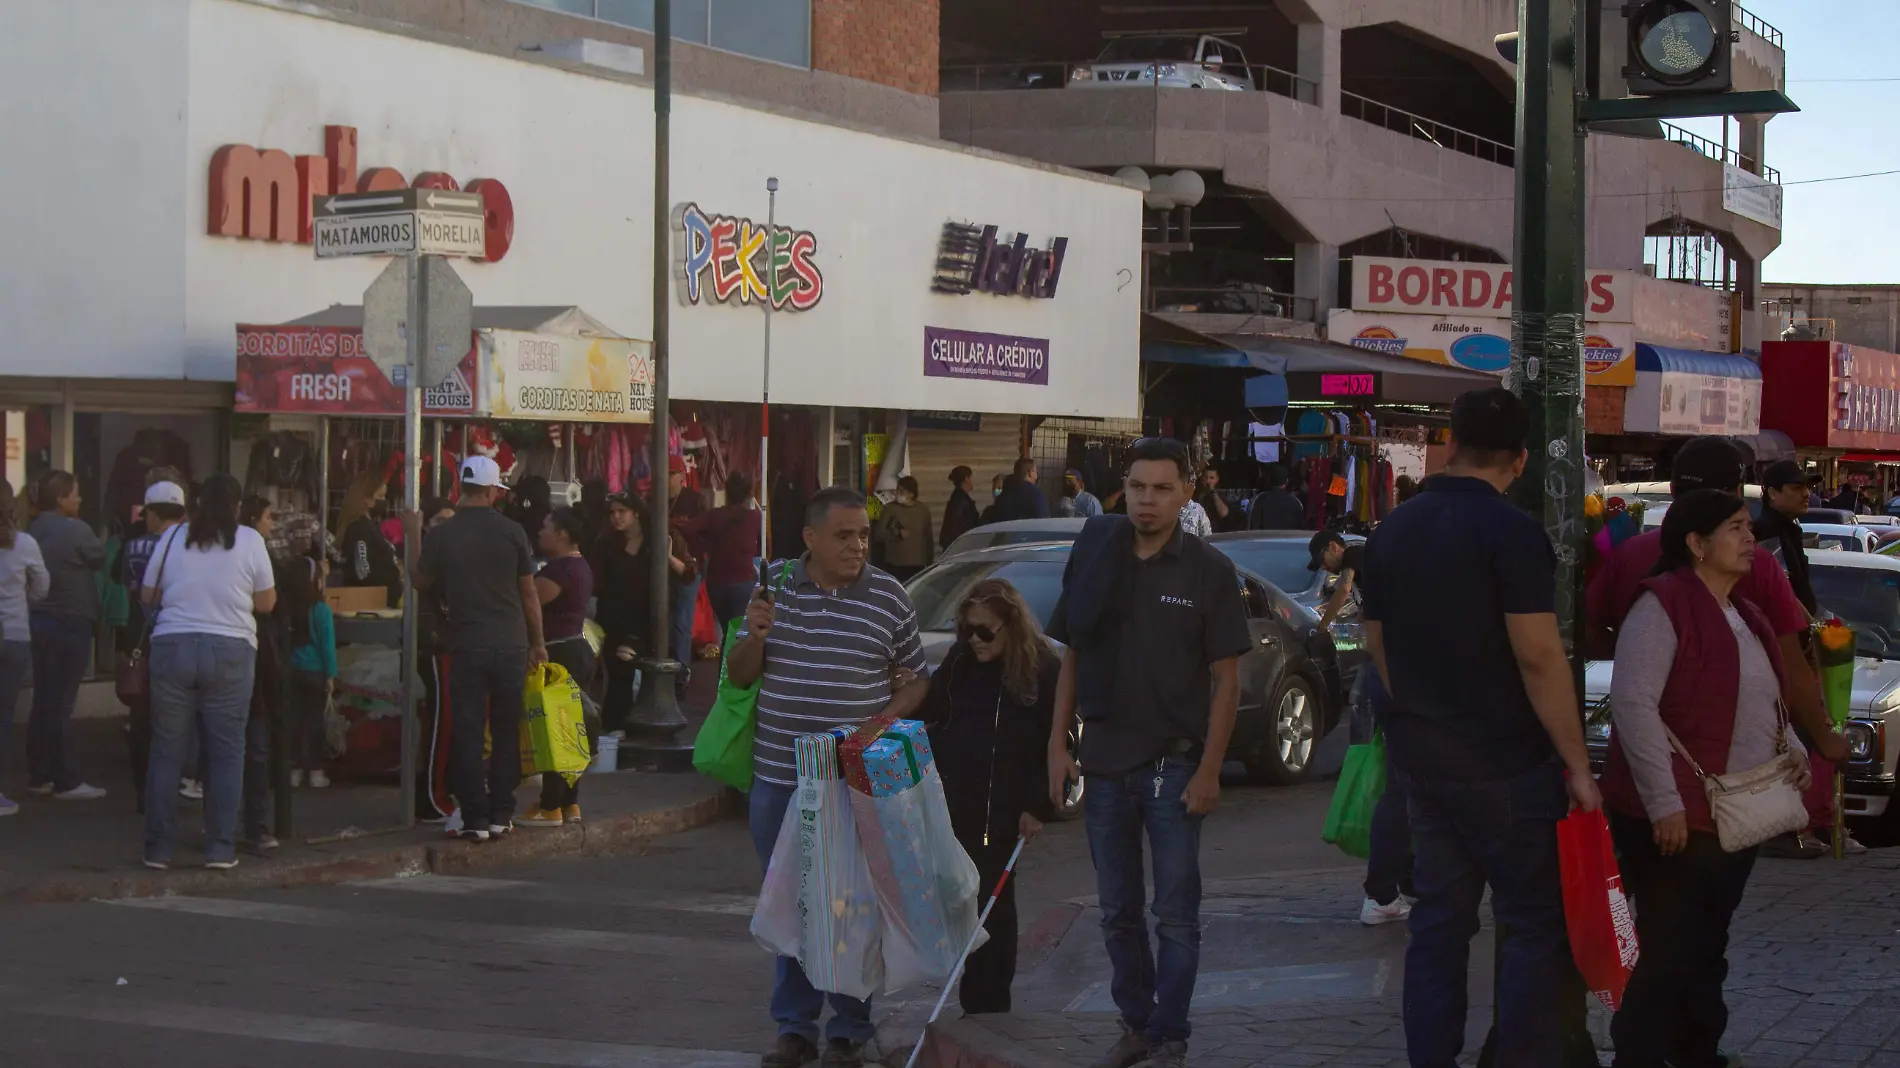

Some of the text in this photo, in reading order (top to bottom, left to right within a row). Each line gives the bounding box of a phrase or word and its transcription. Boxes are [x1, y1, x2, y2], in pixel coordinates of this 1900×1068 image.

[321, 223, 410, 247] MATAMOROS
[422, 223, 481, 244] MORELIA
[682, 202, 823, 311] PEKES
[1368, 264, 1615, 313] BORDAS
[1432, 323, 1471, 333] Afiliado
[931, 338, 1044, 370] CELULAR A CRÉDITO
[1585, 348, 1619, 360] ckies
[291, 374, 351, 401] FRESA
[519, 386, 578, 411] GORDITAS
[578, 389, 594, 411] DE
[594, 390, 625, 413] NATA
[428, 395, 470, 406] HOUSE
